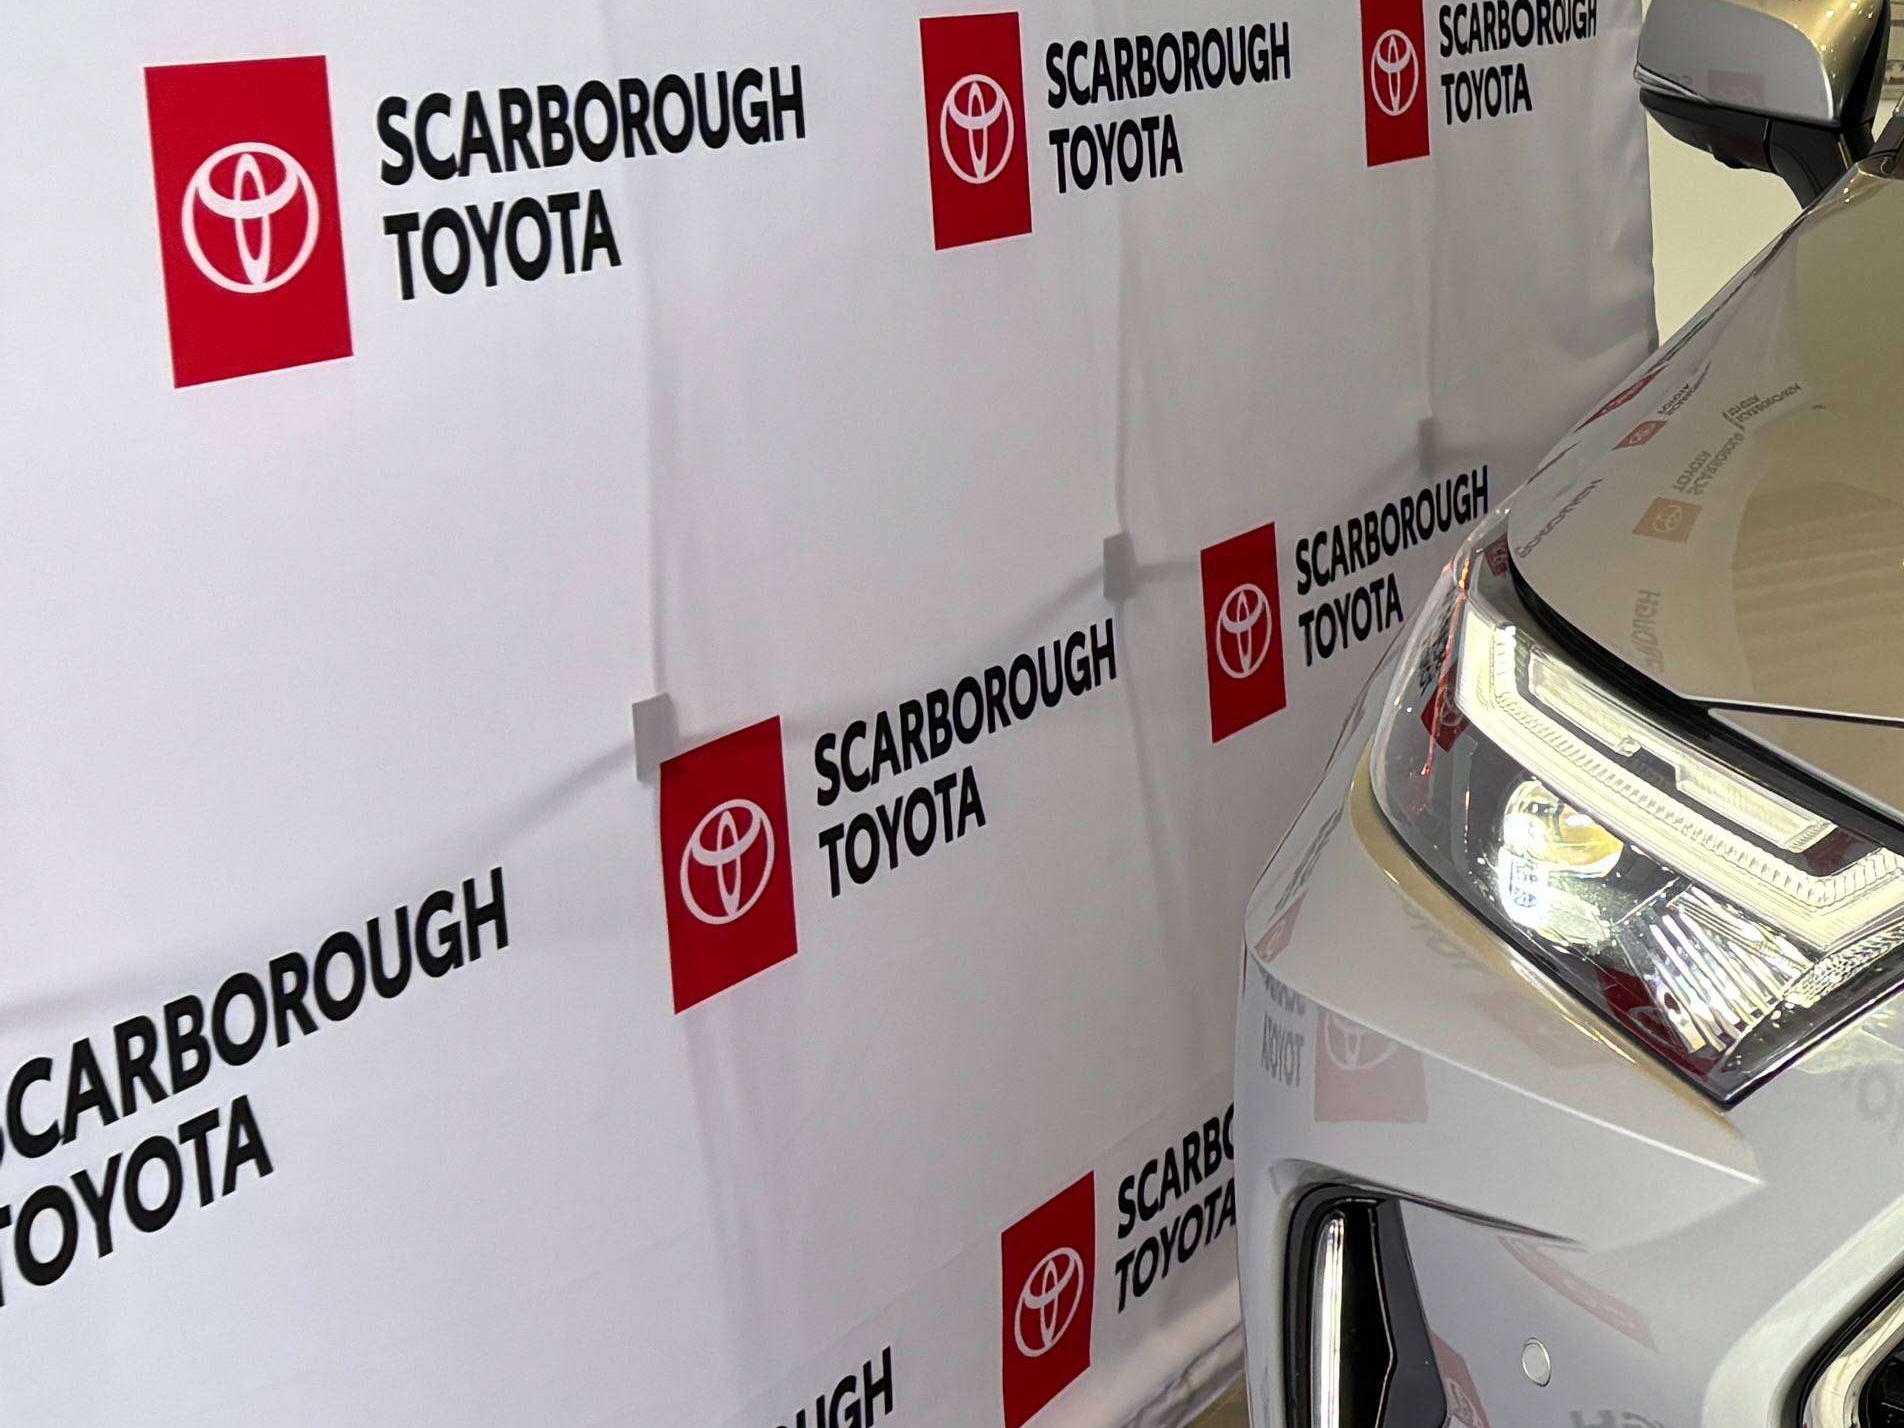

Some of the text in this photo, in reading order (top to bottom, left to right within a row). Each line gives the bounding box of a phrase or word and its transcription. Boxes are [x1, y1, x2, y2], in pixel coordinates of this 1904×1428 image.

[1046, 21, 1292, 110] SCARBOROUGH
[1440, 62, 1533, 125] TOYOTA
[377, 64, 807, 187] SCARBOROUGH
[1048, 113, 1184, 194] TOYOTA
[383, 189, 622, 301] TOYOTA
[1295, 464, 1489, 596] SCARBOROUGH
[1298, 572, 1405, 667] TOYOTA
[813, 618, 1118, 809] SCARBOROUGH
[817, 764, 987, 898] TOYOTA
[0, 865, 509, 1169] CARBOROUGH
